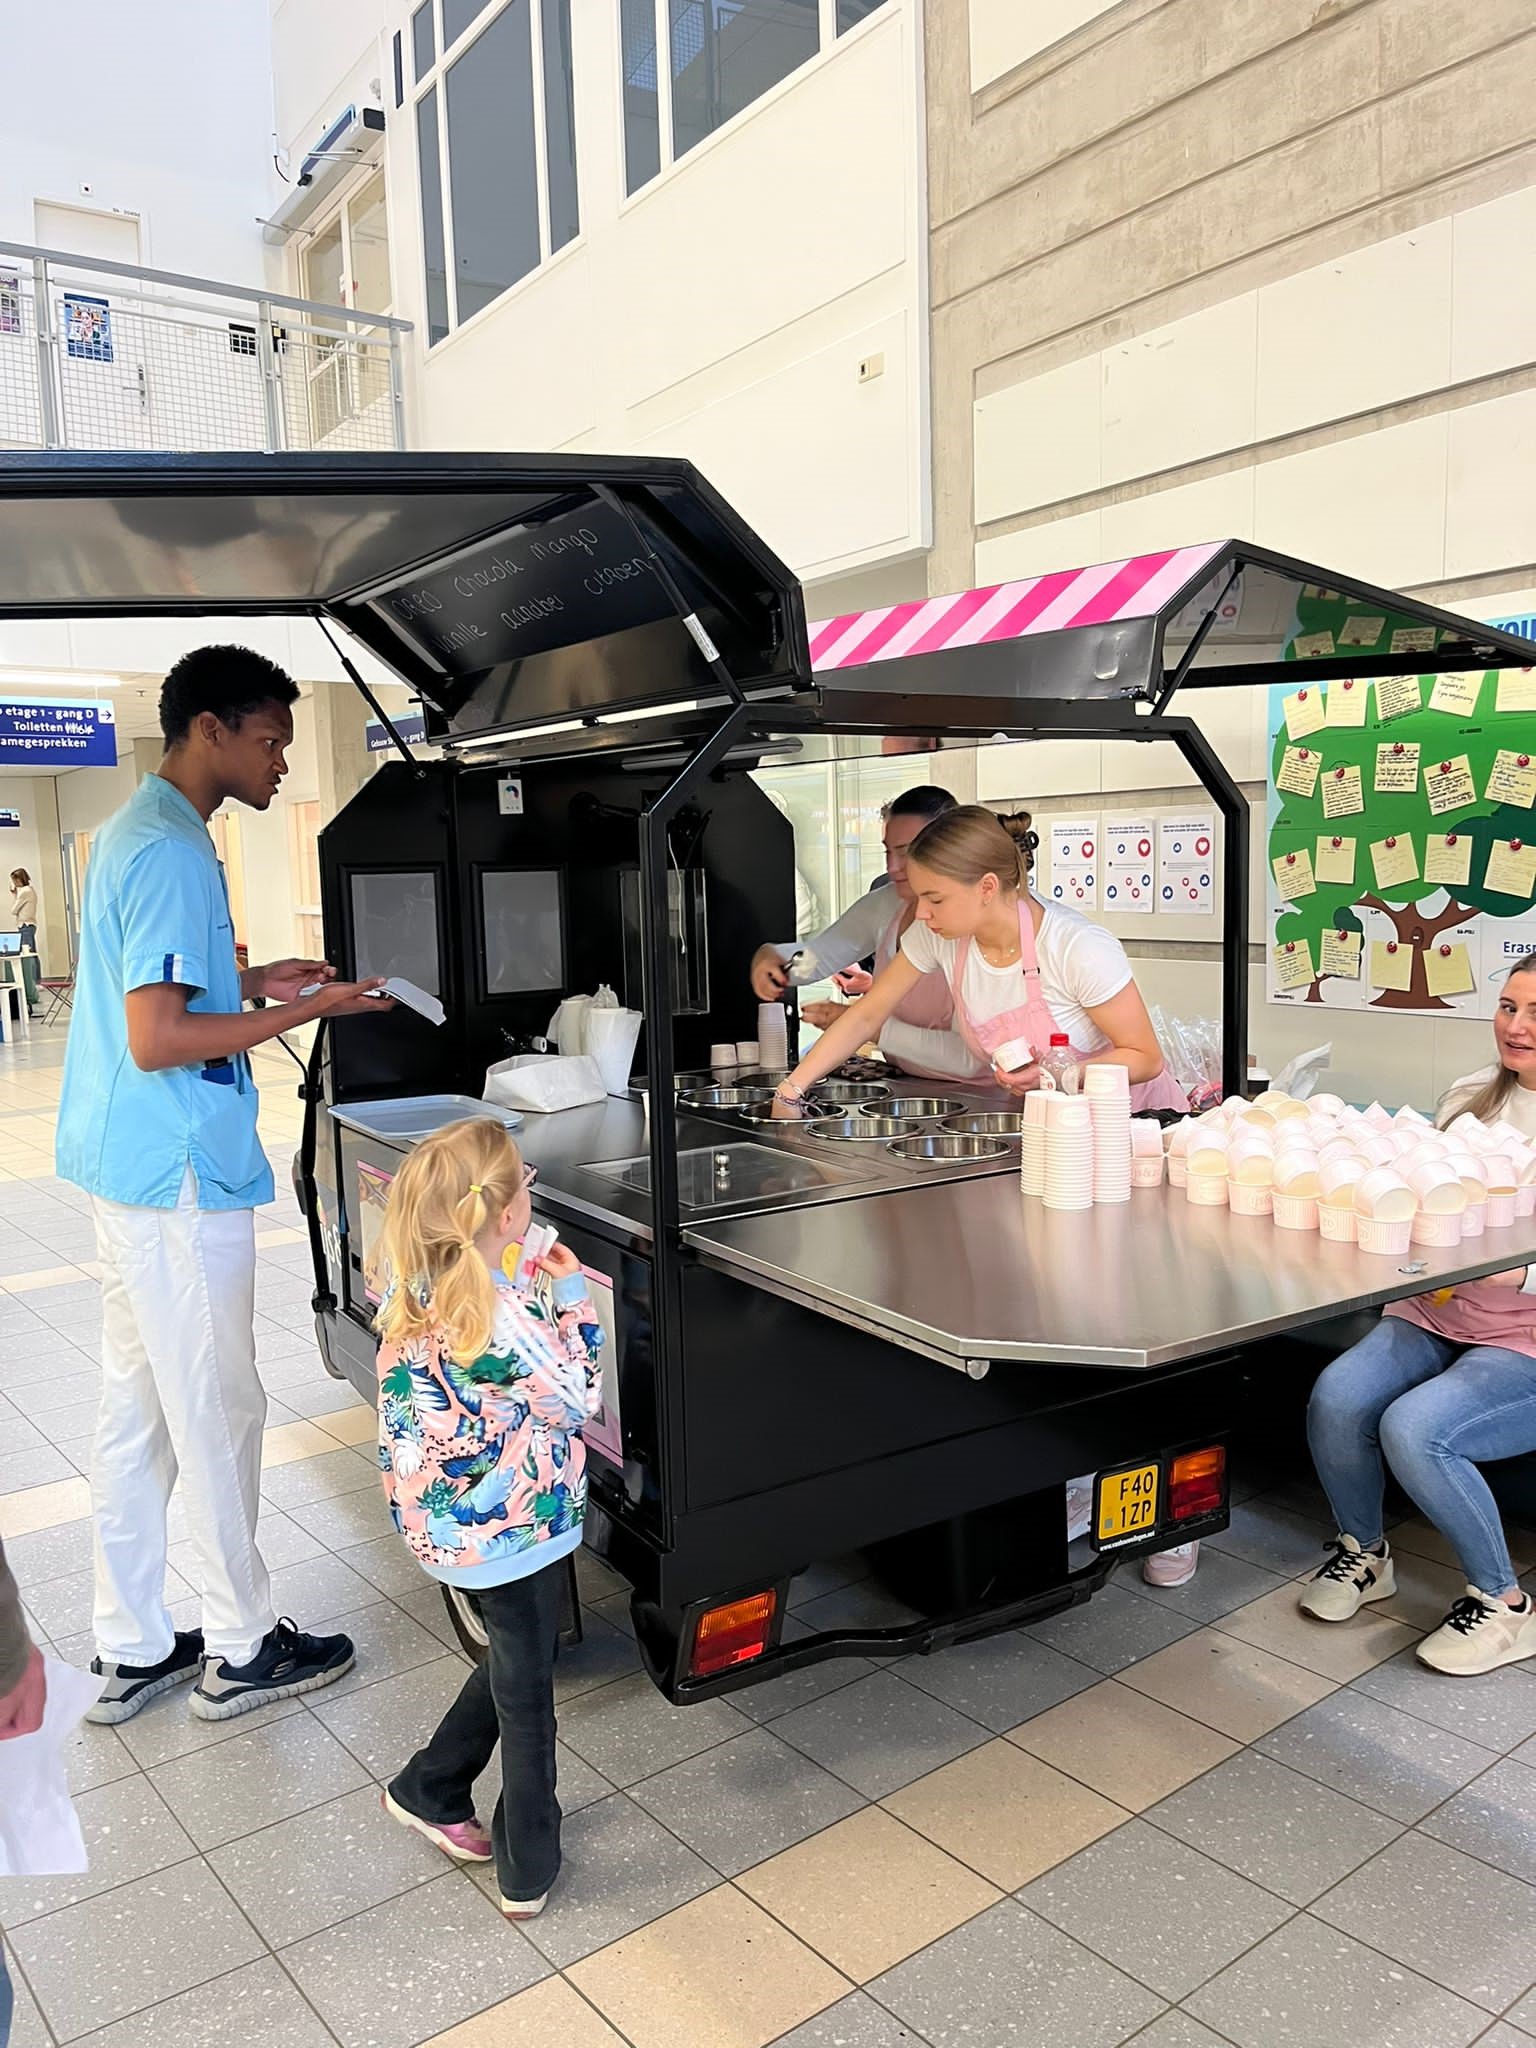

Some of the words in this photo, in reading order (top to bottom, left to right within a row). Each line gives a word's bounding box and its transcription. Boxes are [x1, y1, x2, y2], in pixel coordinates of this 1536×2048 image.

[5, 706, 37, 719] etage
[55, 710, 83, 720] gang
[86, 710, 94, 718] D
[0, 738, 87, 749] amegesprekken
[1119, 1471, 1154, 1501] F40
[1120, 1500, 1152, 1528] 1ZP
